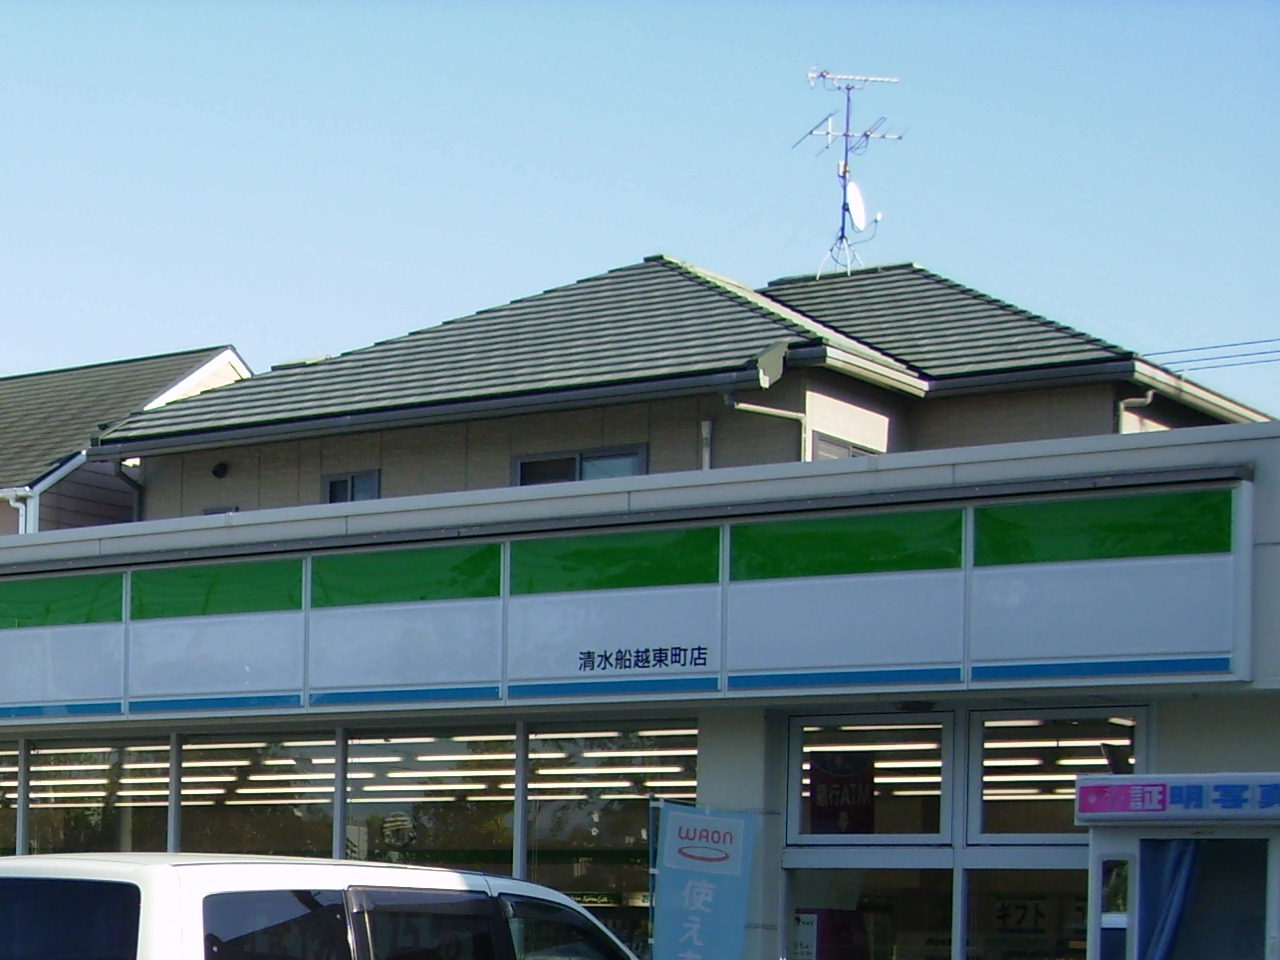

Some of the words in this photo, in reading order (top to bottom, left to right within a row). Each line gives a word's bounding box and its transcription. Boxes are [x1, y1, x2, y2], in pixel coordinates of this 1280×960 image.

[578, 646, 708, 671] 清水船越東町店
[678, 825, 733, 845] WAON
[996, 902, 1046, 927] ギフト
